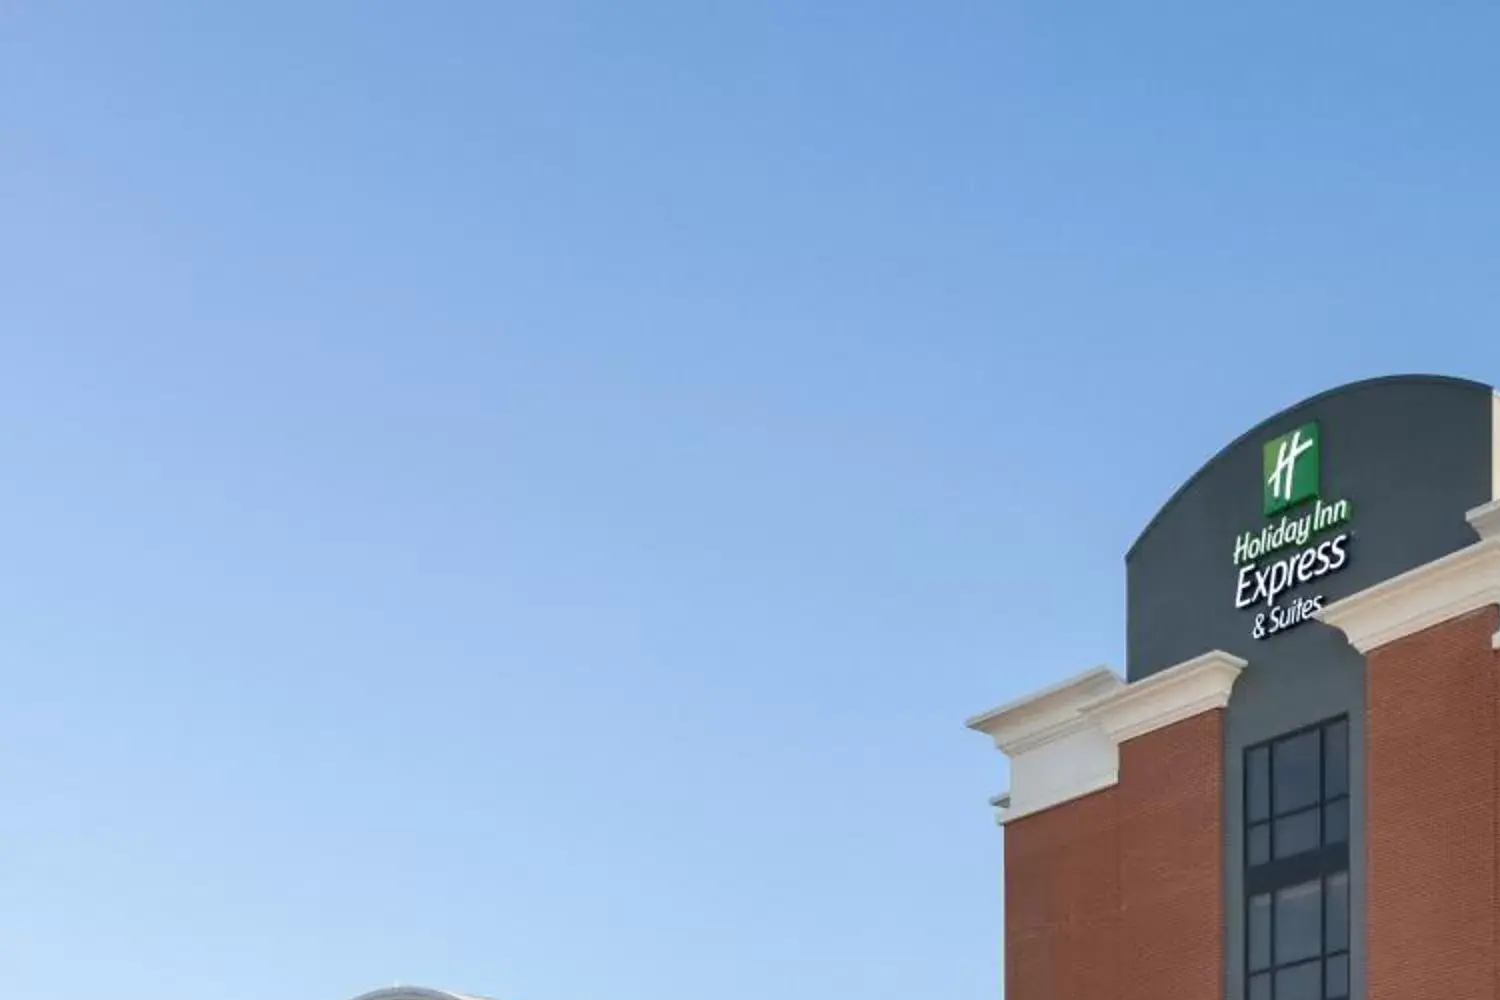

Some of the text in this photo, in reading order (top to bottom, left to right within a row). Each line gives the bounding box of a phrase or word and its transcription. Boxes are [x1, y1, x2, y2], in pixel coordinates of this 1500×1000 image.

[1233, 499, 1347, 565] Holiday Inn
[1235, 534, 1346, 608] Express
[1252, 595, 1324, 640] & Suites
